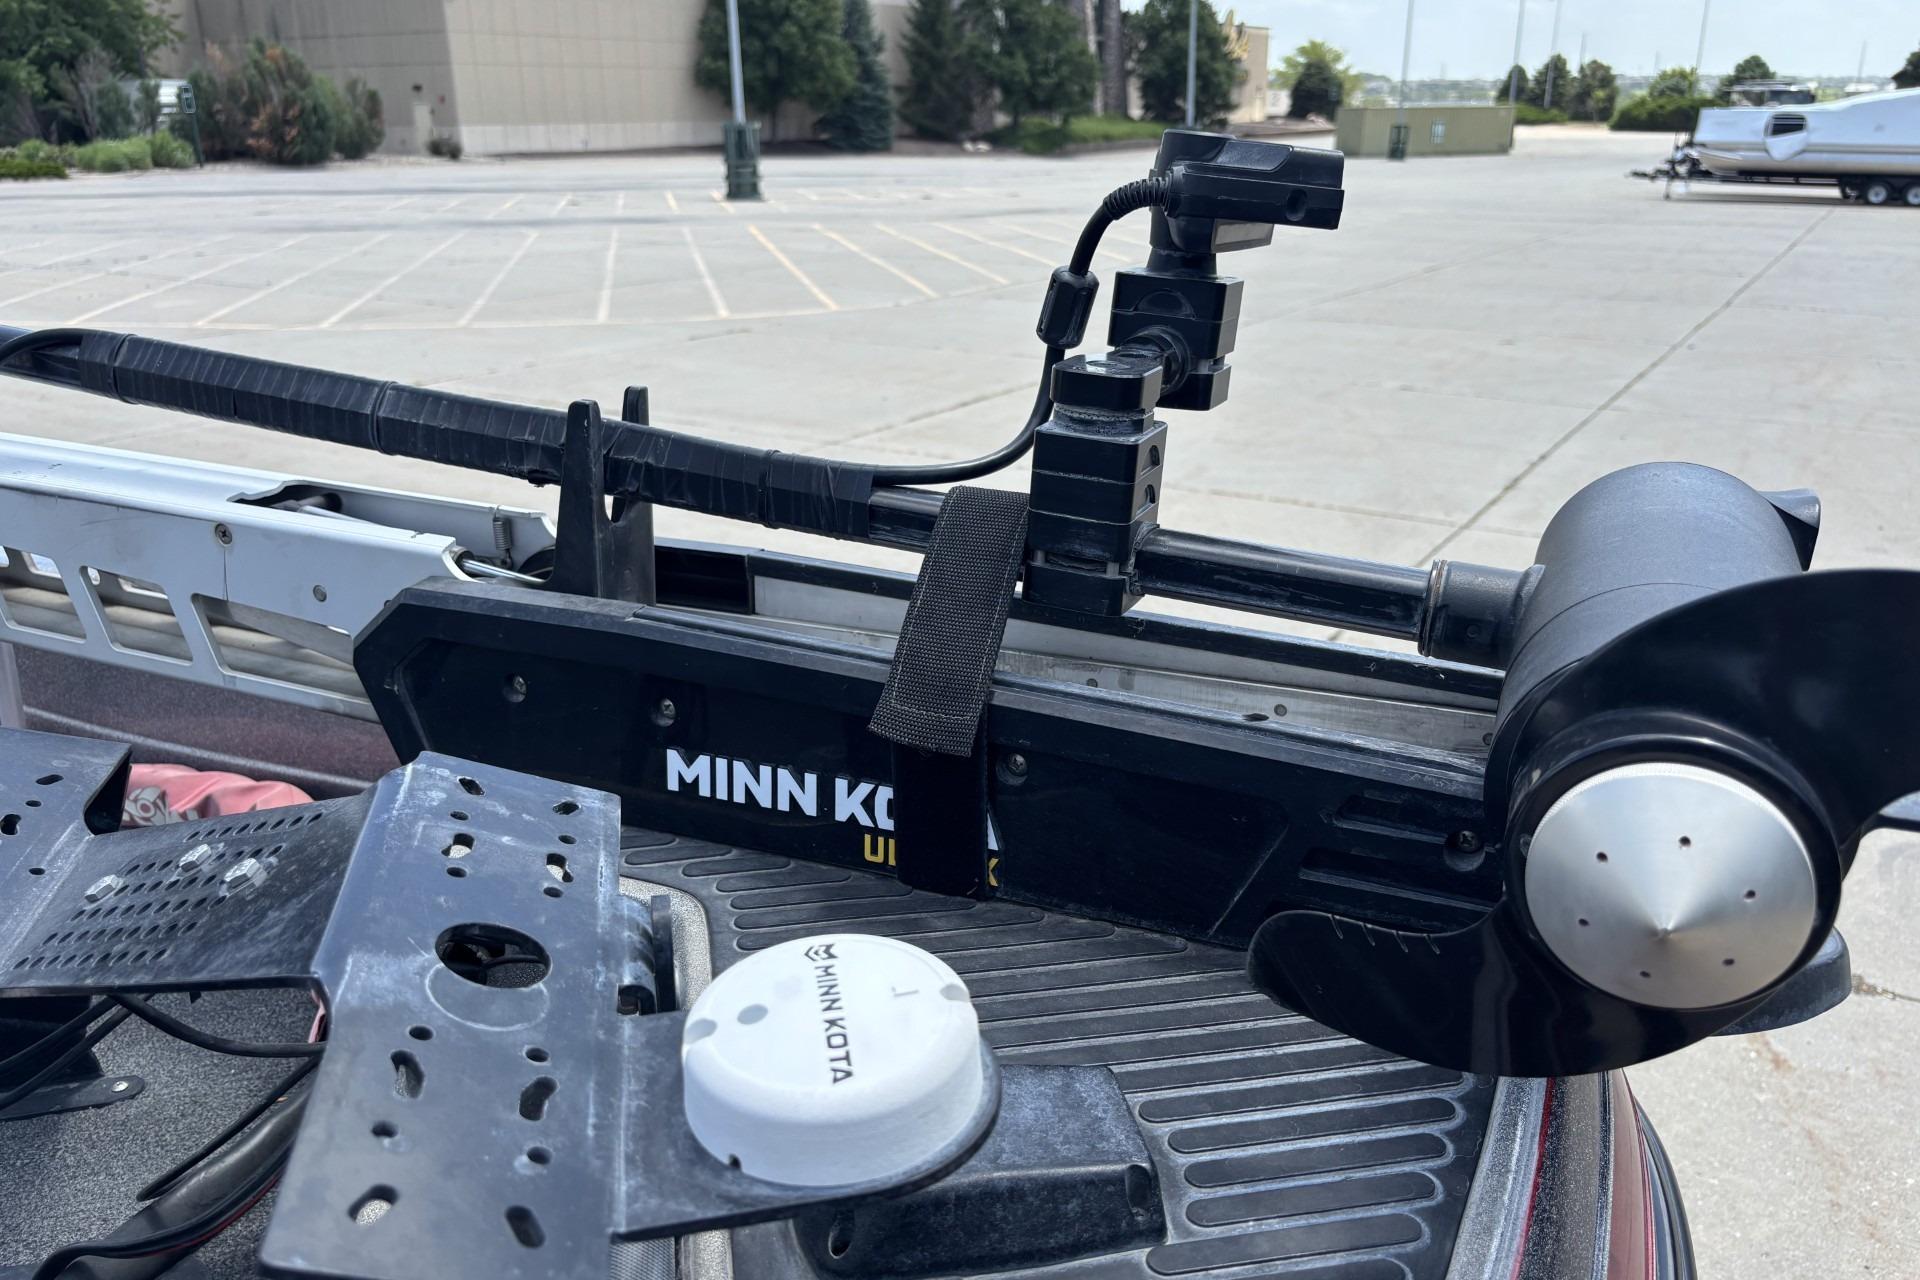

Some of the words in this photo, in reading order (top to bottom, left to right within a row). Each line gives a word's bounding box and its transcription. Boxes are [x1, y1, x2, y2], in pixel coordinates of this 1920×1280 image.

[667, 749, 817, 817] MINN
[814, 964, 843, 1012] MINN
[823, 1017, 854, 1084] KOTA
